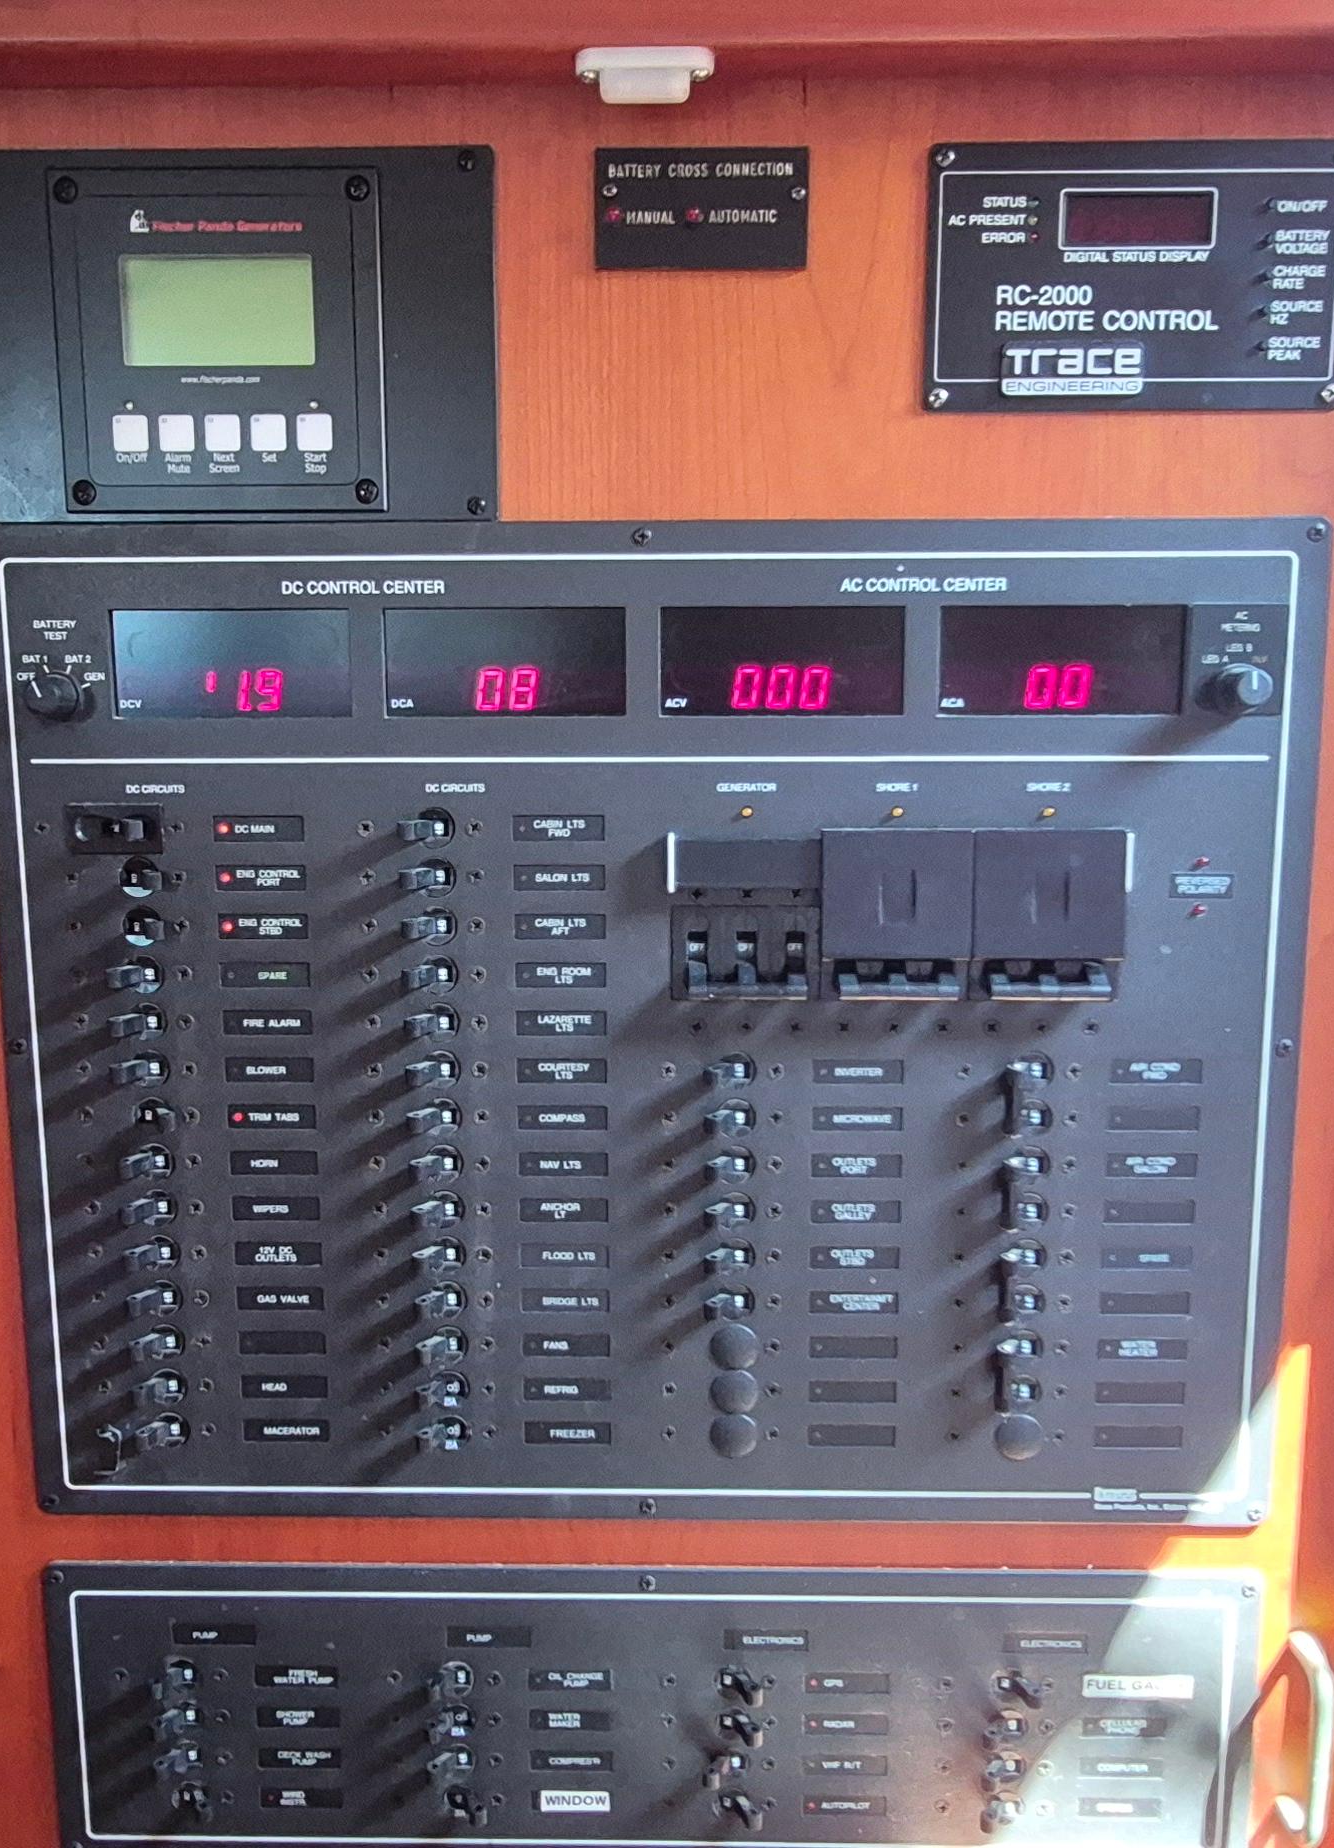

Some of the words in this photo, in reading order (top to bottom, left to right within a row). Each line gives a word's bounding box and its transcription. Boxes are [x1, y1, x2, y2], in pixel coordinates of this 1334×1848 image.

[608, 163, 661, 178] BATTERY
[668, 163, 708, 177] CROSS
[716, 162, 794, 177] CONNECTION
[982, 196, 1027, 208] STATUS
[1277, 200, 1328, 213] ON/OFF
[626, 210, 675, 224] MANUAL
[708, 209, 778, 224] AUTOMATIC
[948, 214, 966, 226] AC
[969, 214, 1026, 226] PRESENT
[981, 232, 1026, 244] ERROR
[1275, 230, 1330, 242] BATTERY
[1275, 242, 1328, 255] VOLTAGE
[1063, 251, 1109, 263] DIGITAL
[1112, 251, 1157, 263] STATUS
[1159, 251, 1210, 263] DISPLAY
[1272, 265, 1326, 277] CHARGE
[1272, 277, 1304, 290] RATE
[996, 285, 1093, 305] RC-2000
[1270, 301, 1323, 313] SOURCE
[995, 310, 1094, 331] REMOTE
[1103, 310, 1219, 331] CONTROL
[1270, 313, 1289, 325] HZ
[1268, 336, 1320, 348] SOURCE
[1268, 348, 1301, 361] PEAK
[1005, 380, 1139, 393] ENGINEERING
[117, 452, 148, 464] On/Off
[165, 452, 191, 463] Alarm
[213, 452, 235, 463] Next
[262, 452, 277, 463] Set
[304, 452, 327, 463] Start
[168, 464, 190, 474] Mute
[209, 463, 240, 474] Screen
[305, 463, 327, 475] Stop
[281, 581, 304, 594] DC
[307, 581, 379, 594] CONTROL
[383, 580, 445, 594] CENTER
[840, 578, 863, 592] AC
[866, 577, 940, 592] CONTROL
[944, 577, 1007, 592] CENTER
[33, 620, 77, 629] BATTERY
[44, 631, 67, 640] TEST
[22, 655, 43, 663] BAT
[65, 655, 83, 663] BAT
[84, 655, 92, 663] 2
[17, 672, 36, 681] OFF
[84, 672, 106, 681] GEN
[474, 666, 540, 711] 08
[731, 664, 832, 710] 000
[1024, 663, 1094, 710] 00
[120, 700, 142, 708] DCV
[391, 699, 414, 709] DCA
[665, 698, 687, 708] ACV
[940, 698, 964, 708] ACA
[126, 785, 140, 793] DC
[141, 784, 185, 794] CIRCUITS
[425, 783, 439, 793] DC
[441, 783, 485, 793] CIRCUITS
[716, 783, 777, 792] GENERATOR
[875, 782, 911, 792] SHORE
[1026, 782, 1061, 792] SHORE
[235, 825, 249, 834] DC
[250, 825, 275, 834] MAIN
[533, 820, 563, 829] CABIN
[567, 820, 586, 829] LTS
[548, 829, 570, 838] FWD
[236, 870, 255, 879] ENG
[259, 870, 300, 879] CONTROL
[535, 873, 567, 882] SALON
[571, 873, 590, 882] LTS
[257, 878, 280, 887] PORT
[238, 918, 257, 927] ENG
[261, 918, 302, 927] CONTROL
[535, 918, 565, 927] CABIN
[568, 918, 586, 927] LTS
[551, 926, 569, 935] AFT
[257, 971, 287, 980] SPARE
[536, 967, 559, 976] ENG
[561, 967, 592, 976] ROOM
[555, 975, 574, 984] LTS
[243, 1019, 264, 1027] FIRE
[268, 1019, 301, 1027] ALARM
[537, 1015, 592, 1024] LAZARETTE
[555, 1023, 574, 1032] LTS
[246, 1066, 286, 1075] BLOWER
[538, 1063, 589, 1072] COURTESY
[555, 1071, 573, 1080] LTS
[248, 1113, 271, 1122] TRIM
[539, 1114, 586, 1123] COMPASS
[250, 1159, 278, 1168] HORN
[540, 1160, 559, 1170] NAV
[563, 1160, 582, 1170] LTS
[252, 1205, 289, 1214] WIPERS
[540, 1202, 581, 1211] ANCHOR
[555, 1210, 566, 1219] LT
[259, 1246, 276, 1254] 12V
[278, 1246, 293, 1254] DC
[255, 1254, 297, 1263] OUTLETS
[542, 1252, 574, 1261] FLOOD
[577, 1252, 596, 1261] LTS
[257, 1295, 277, 1304] GAS
[280, 1295, 309, 1304] VALVE
[581, 1297, 599, 1306] LTS
[543, 1341, 569, 1350] FANS
[262, 1383, 287, 1392] HEAD
[264, 1426, 320, 1436] MACERATOR
[550, 1429, 595, 1438] FREEZER
[1086, 1678, 1126, 1691] FUEL
[545, 1796, 607, 1806] WINDOW
